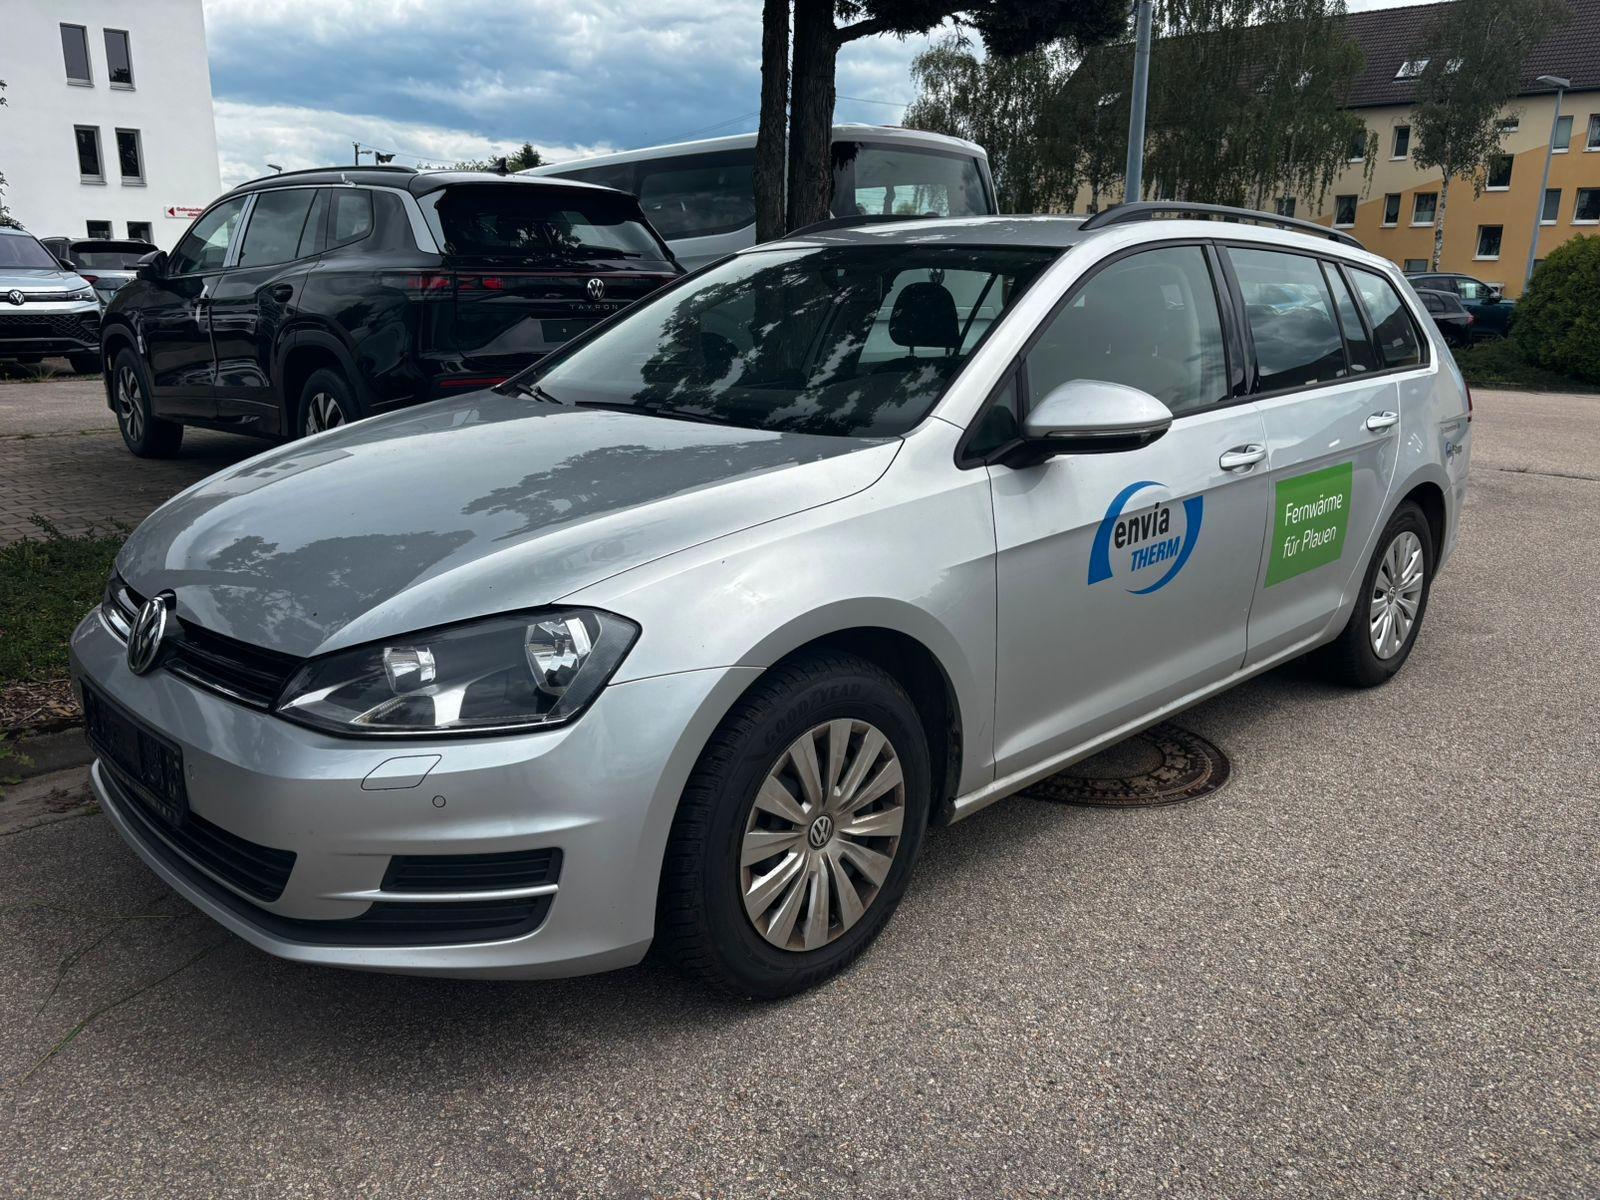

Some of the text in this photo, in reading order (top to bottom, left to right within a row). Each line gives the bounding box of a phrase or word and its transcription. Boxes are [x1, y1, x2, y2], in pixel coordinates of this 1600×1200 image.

[1284, 493, 1343, 527] Fernwärme
[1131, 535, 1181, 572] THERM
[1283, 526, 1337, 559] für Plauen
[764, 682, 862, 748] GOODYEAR
